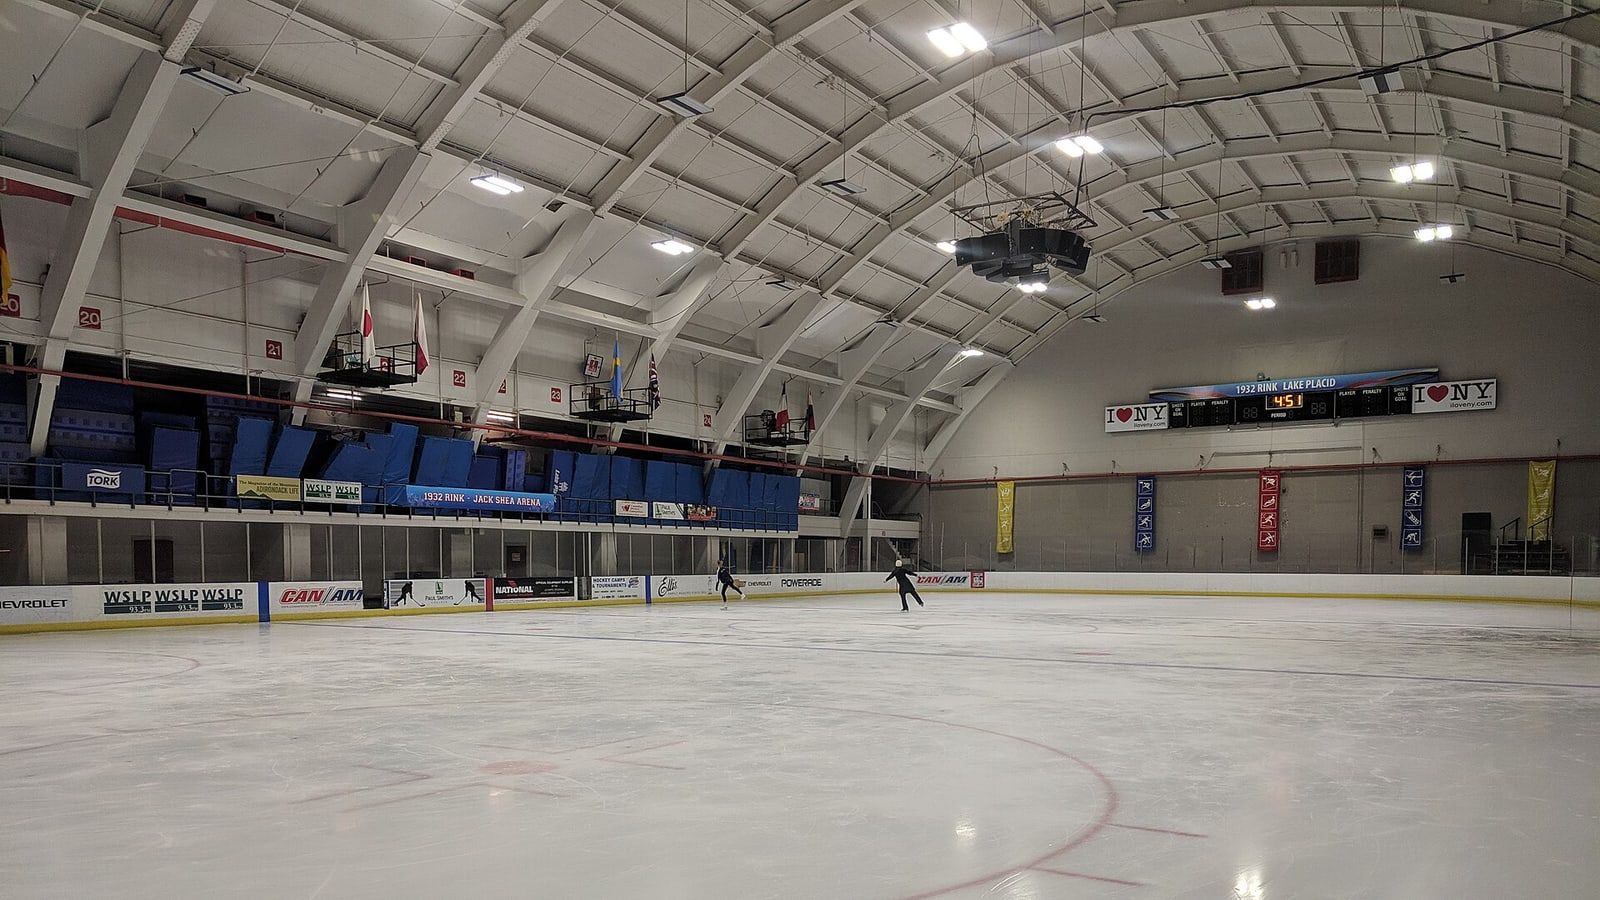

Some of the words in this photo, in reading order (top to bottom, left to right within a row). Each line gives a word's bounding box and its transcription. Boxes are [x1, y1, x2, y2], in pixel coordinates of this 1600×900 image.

[80, 310, 100, 327] 20
[267, 343, 281, 357] 21
[453, 373, 465, 385] 22
[1236, 385, 1256, 394] 1932
[1257, 382, 1278, 393] RINK
[1283, 381, 1304, 390] LAKE
[1305, 378, 1336, 388] PLACID
[1414, 386, 1426, 403] I
[1450, 381, 1495, 400] NY
[551, 390, 561, 400] 23
[1273, 394, 1302, 408] 4:51
[1450, 400, 1493, 408] iloveny.com
[1106, 408, 1115, 423] I
[1134, 405, 1166, 421] NY
[1134, 421, 1166, 429] iloveny.com
[88, 475, 119, 487] TORK
[288, 487, 300, 495] LIFE
[306, 483, 332, 493] WSLP
[335, 485, 360, 494] WSLP
[423, 491, 443, 502] 1932
[444, 492, 465, 503] RINK
[473, 494, 494, 504] JACK
[495, 495, 515, 505] SHEA
[516, 496, 541, 507] ARENA
[781, 578, 822, 587] POWERADE
[155, 589, 199, 601] WSLP
[202, 588, 243, 600] WSLP
[495, 585, 534, 594] NATIONAL
[104, 590, 152, 602] WSLP
[0, 599, 68, 609] EVROLET
